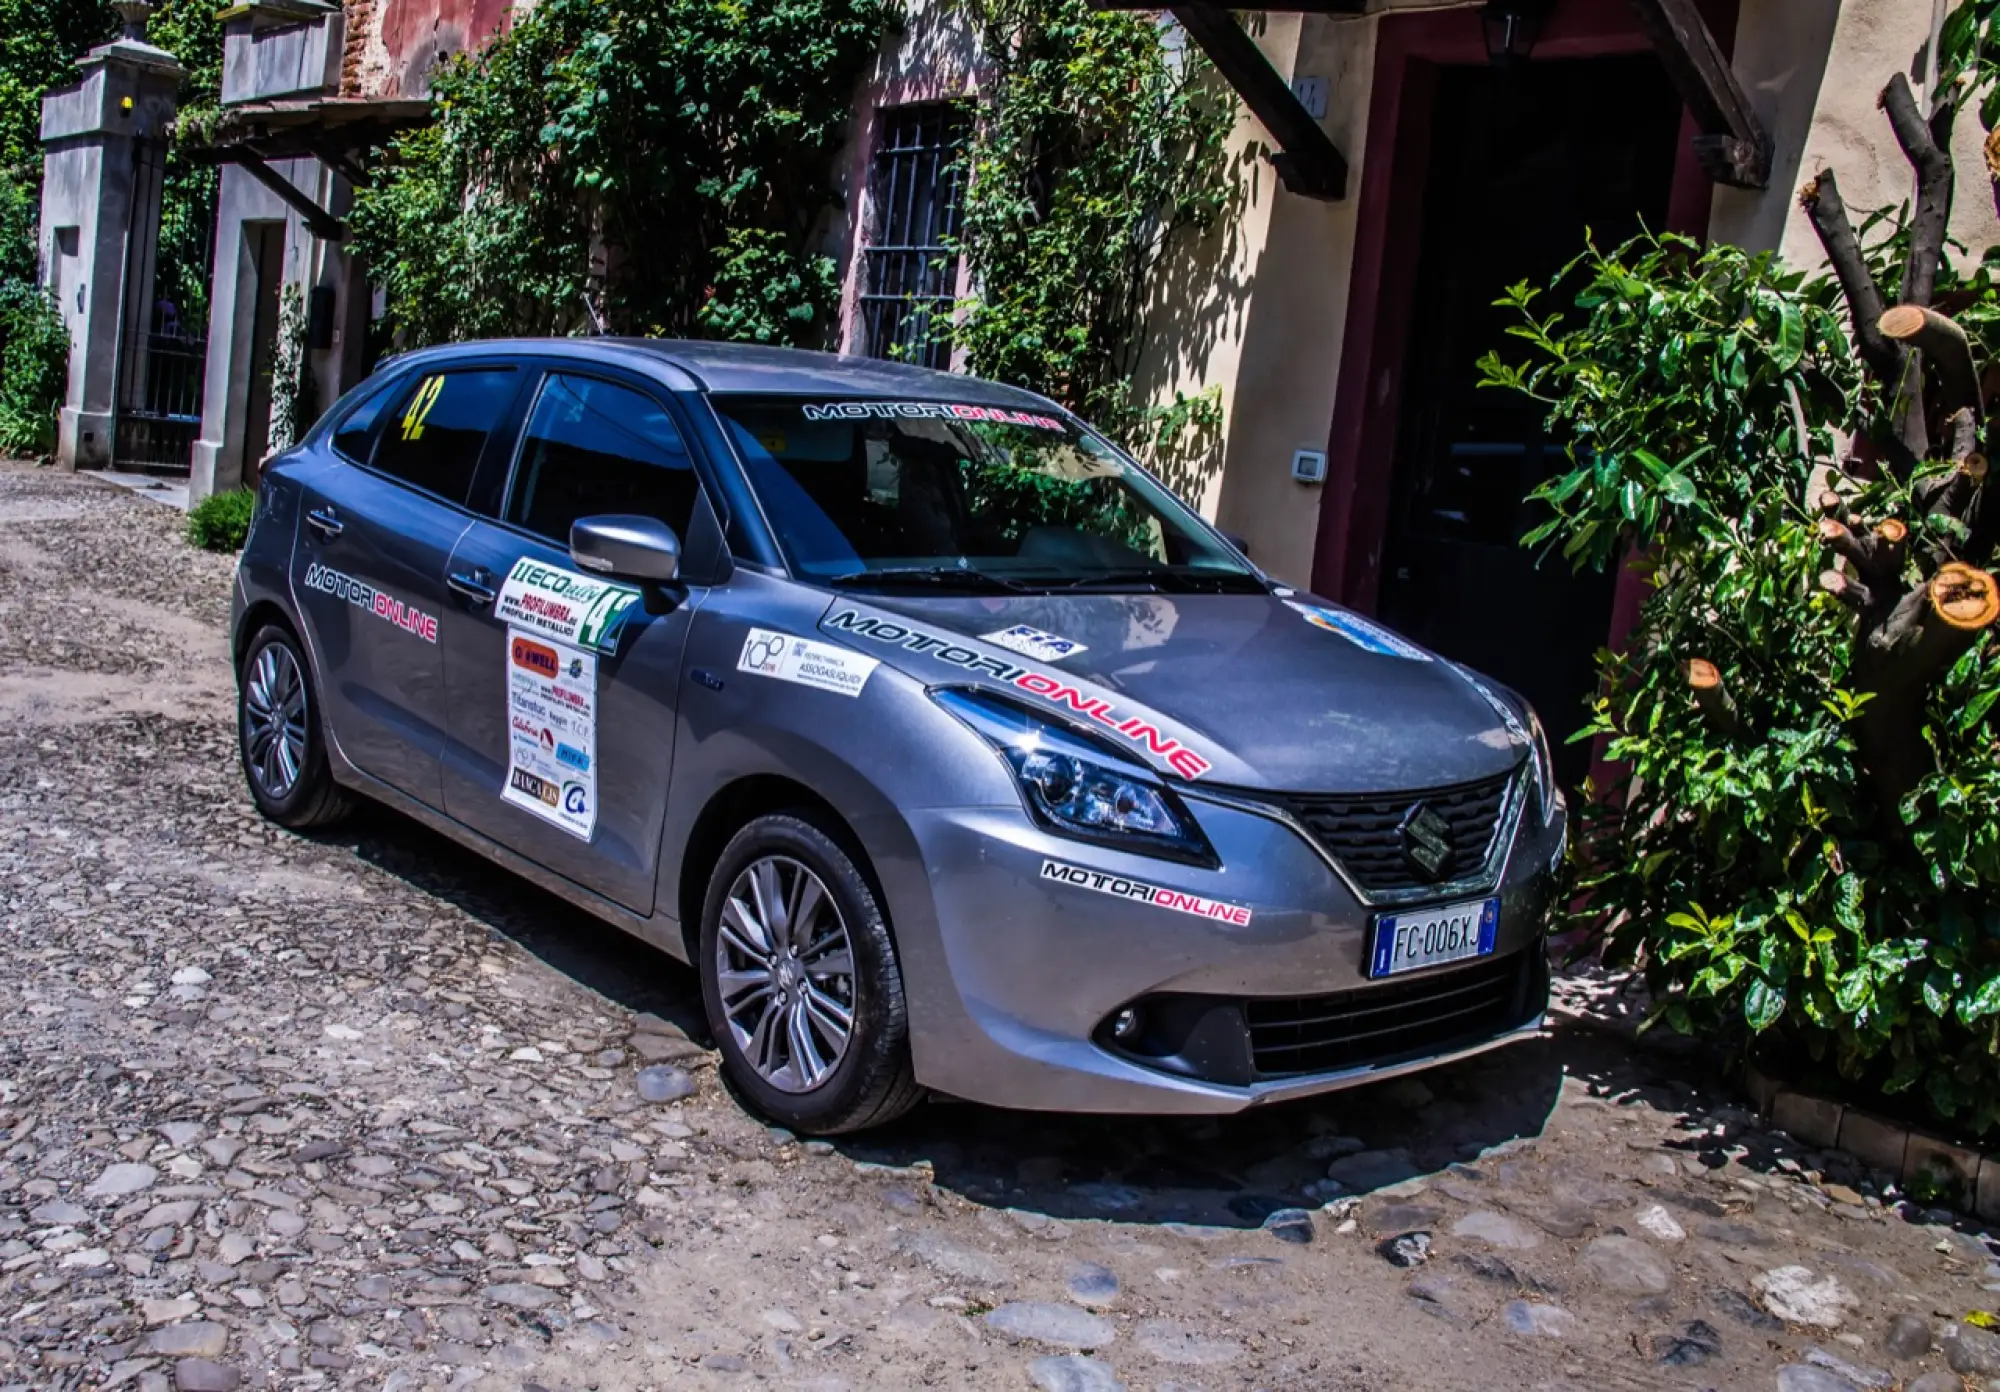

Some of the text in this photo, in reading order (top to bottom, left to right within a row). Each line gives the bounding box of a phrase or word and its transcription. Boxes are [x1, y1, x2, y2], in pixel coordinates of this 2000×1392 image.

[402, 374, 445, 440] 42
[304, 562, 438, 644] MOTORIONLINE
[825, 608, 1212, 781] MOTORIONLINE
[1042, 863, 1250, 925] MOTORIONLINE
